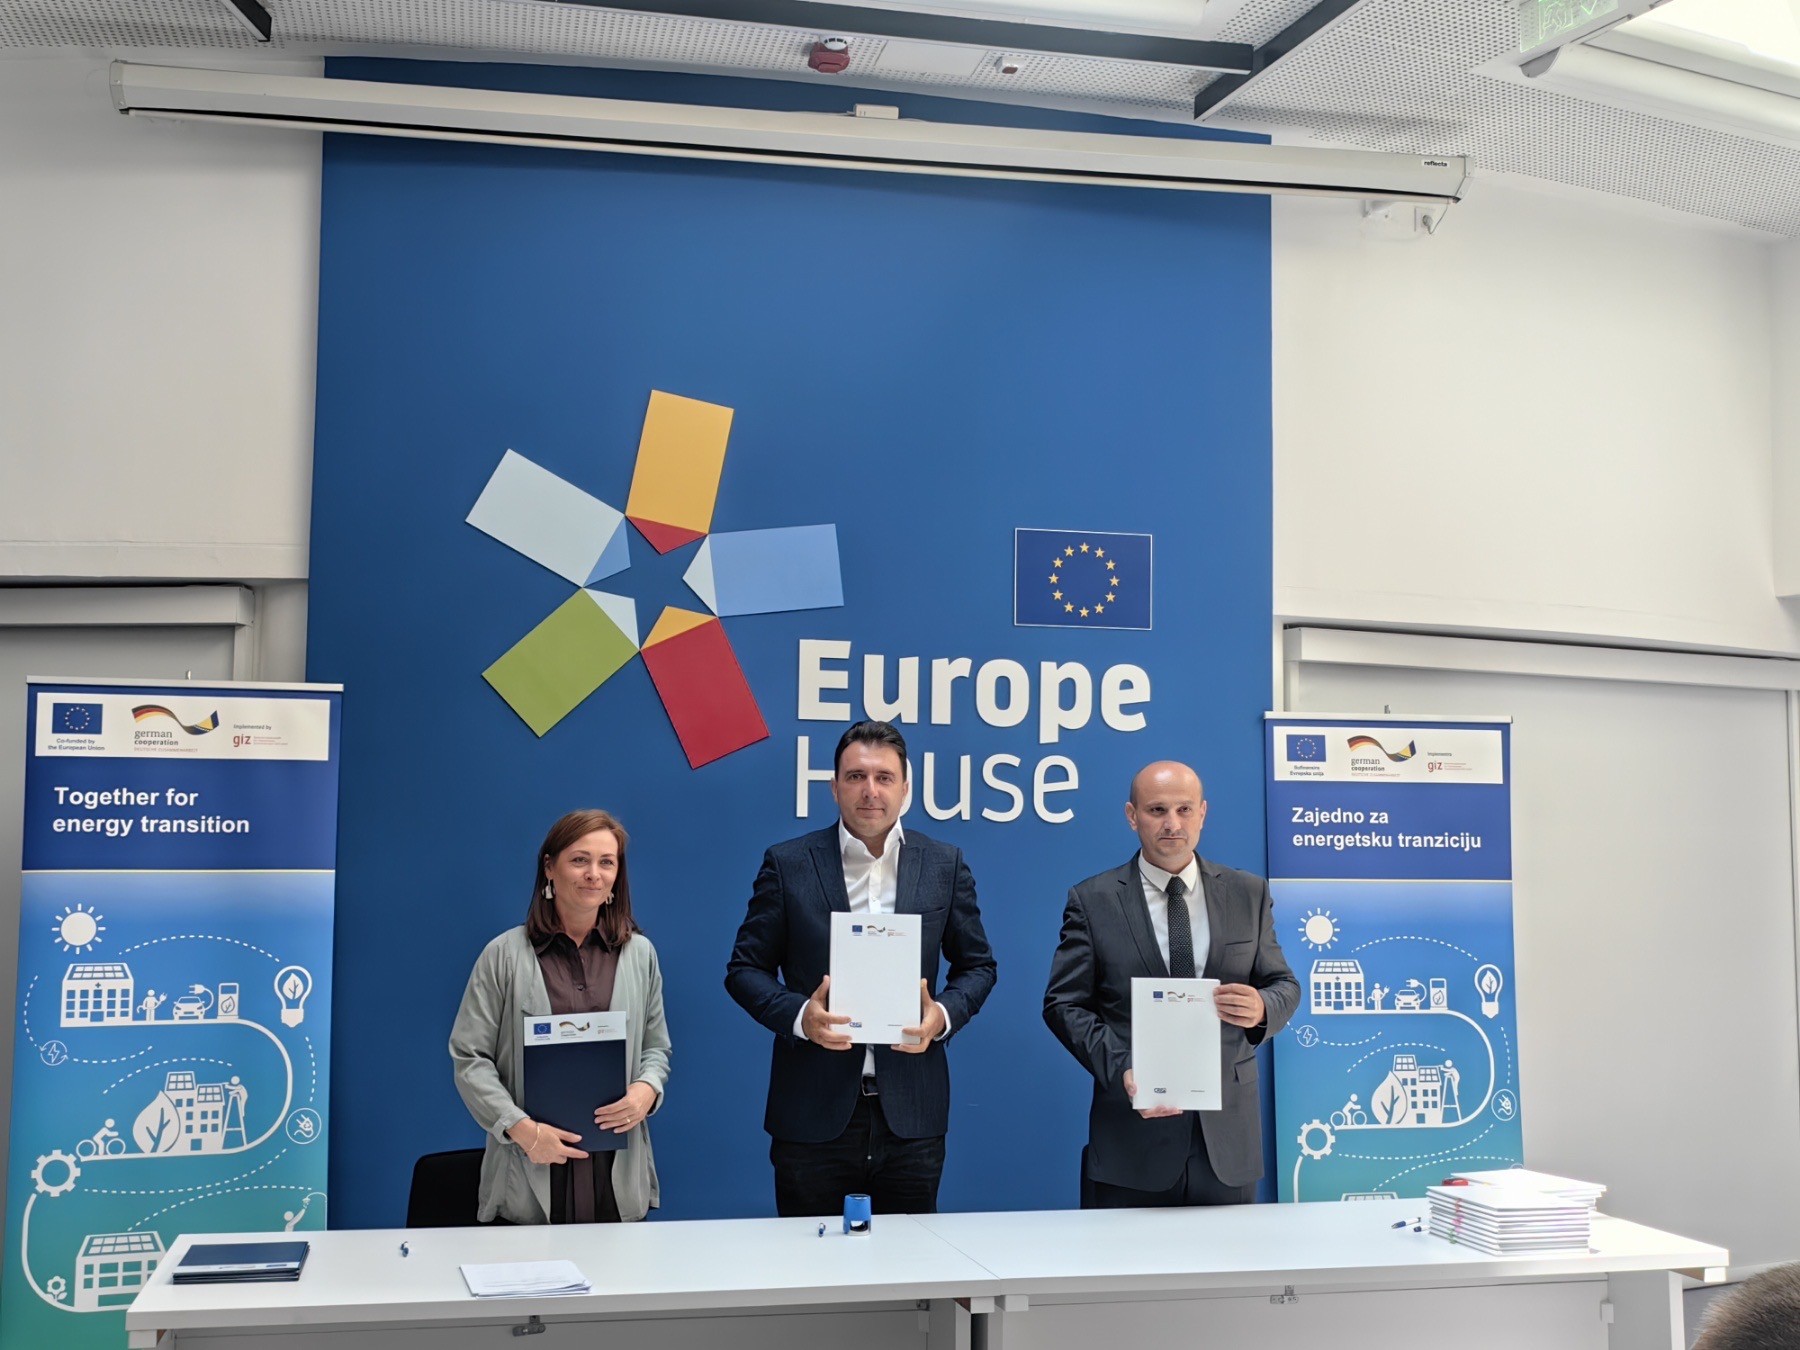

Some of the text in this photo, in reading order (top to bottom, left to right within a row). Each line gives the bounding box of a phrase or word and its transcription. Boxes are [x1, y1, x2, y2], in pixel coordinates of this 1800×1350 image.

[798, 639, 1151, 744] Europe
[134, 730, 173, 740] german
[233, 733, 251, 748] giz
[1350, 758, 1380, 766] german
[1427, 760, 1443, 773] giz
[796, 735, 1079, 823] Huse
[54, 786, 199, 810] Together for
[52, 815, 250, 837] energy transition
[1291, 807, 1389, 827] Zajedno za
[1292, 832, 1482, 852] energetsku tranziciju
